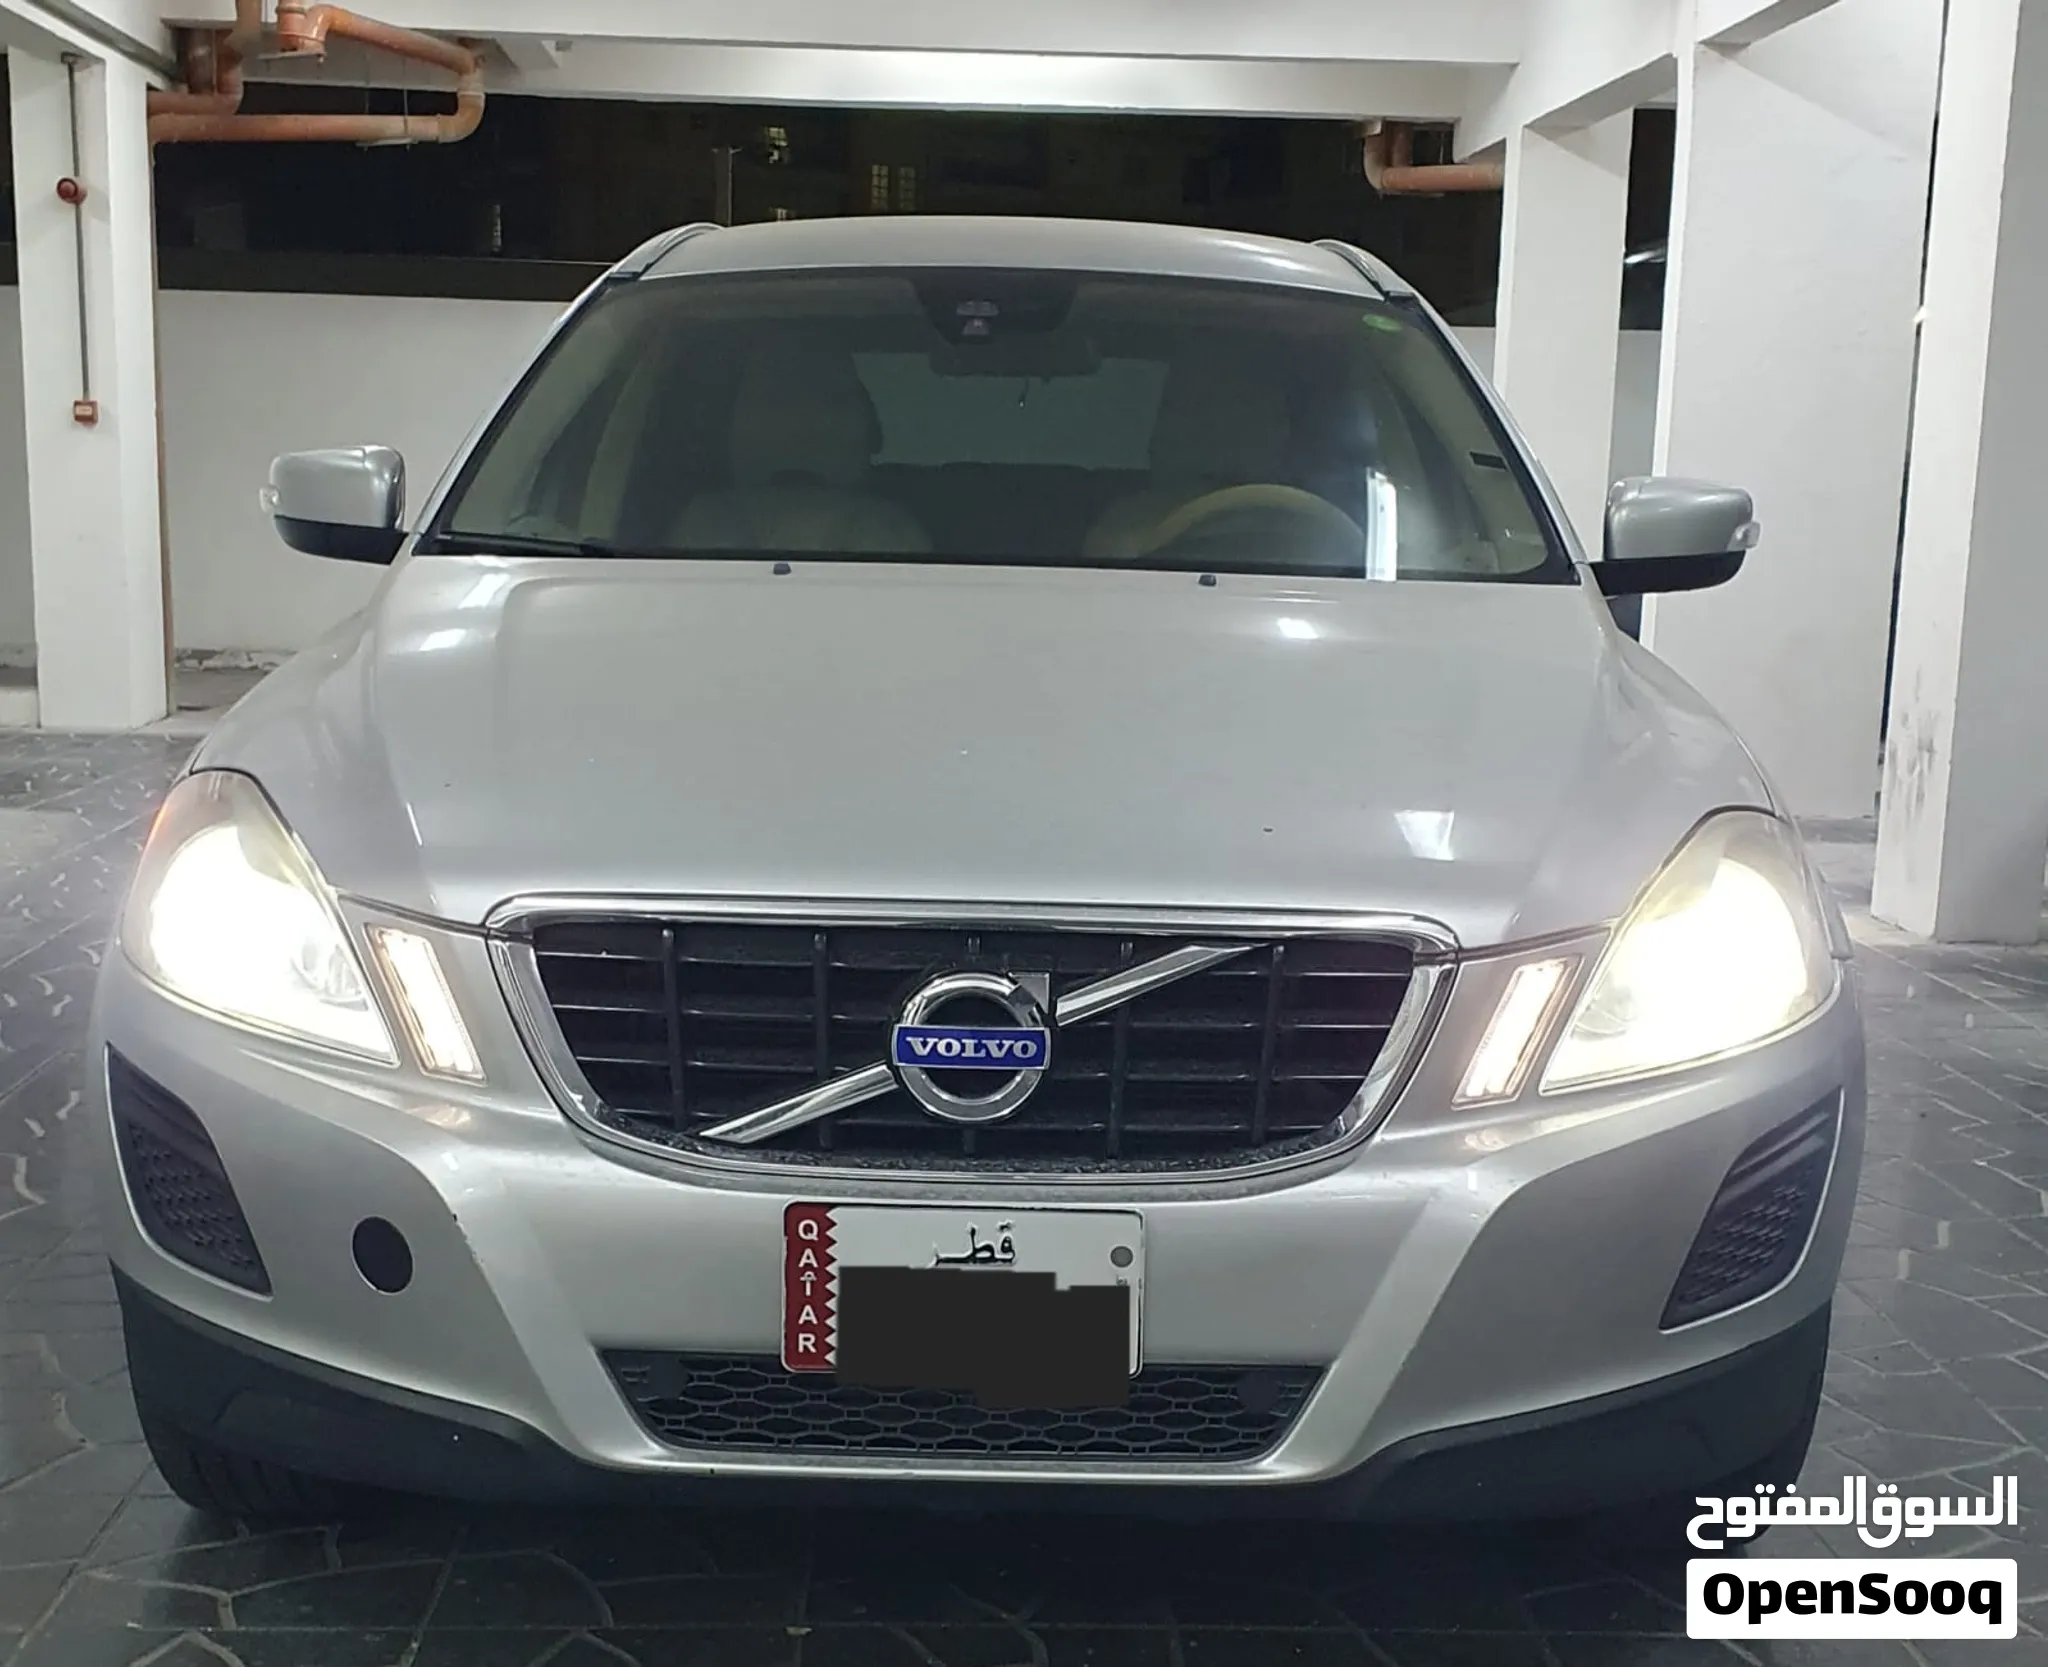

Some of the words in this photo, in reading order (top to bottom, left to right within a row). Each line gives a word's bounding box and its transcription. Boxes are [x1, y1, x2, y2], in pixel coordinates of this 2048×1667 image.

[905, 1036, 1038, 1059] VOLVO
[932, 1221, 1016, 1267] قطر
[798, 1219, 819, 1353] QATAR
